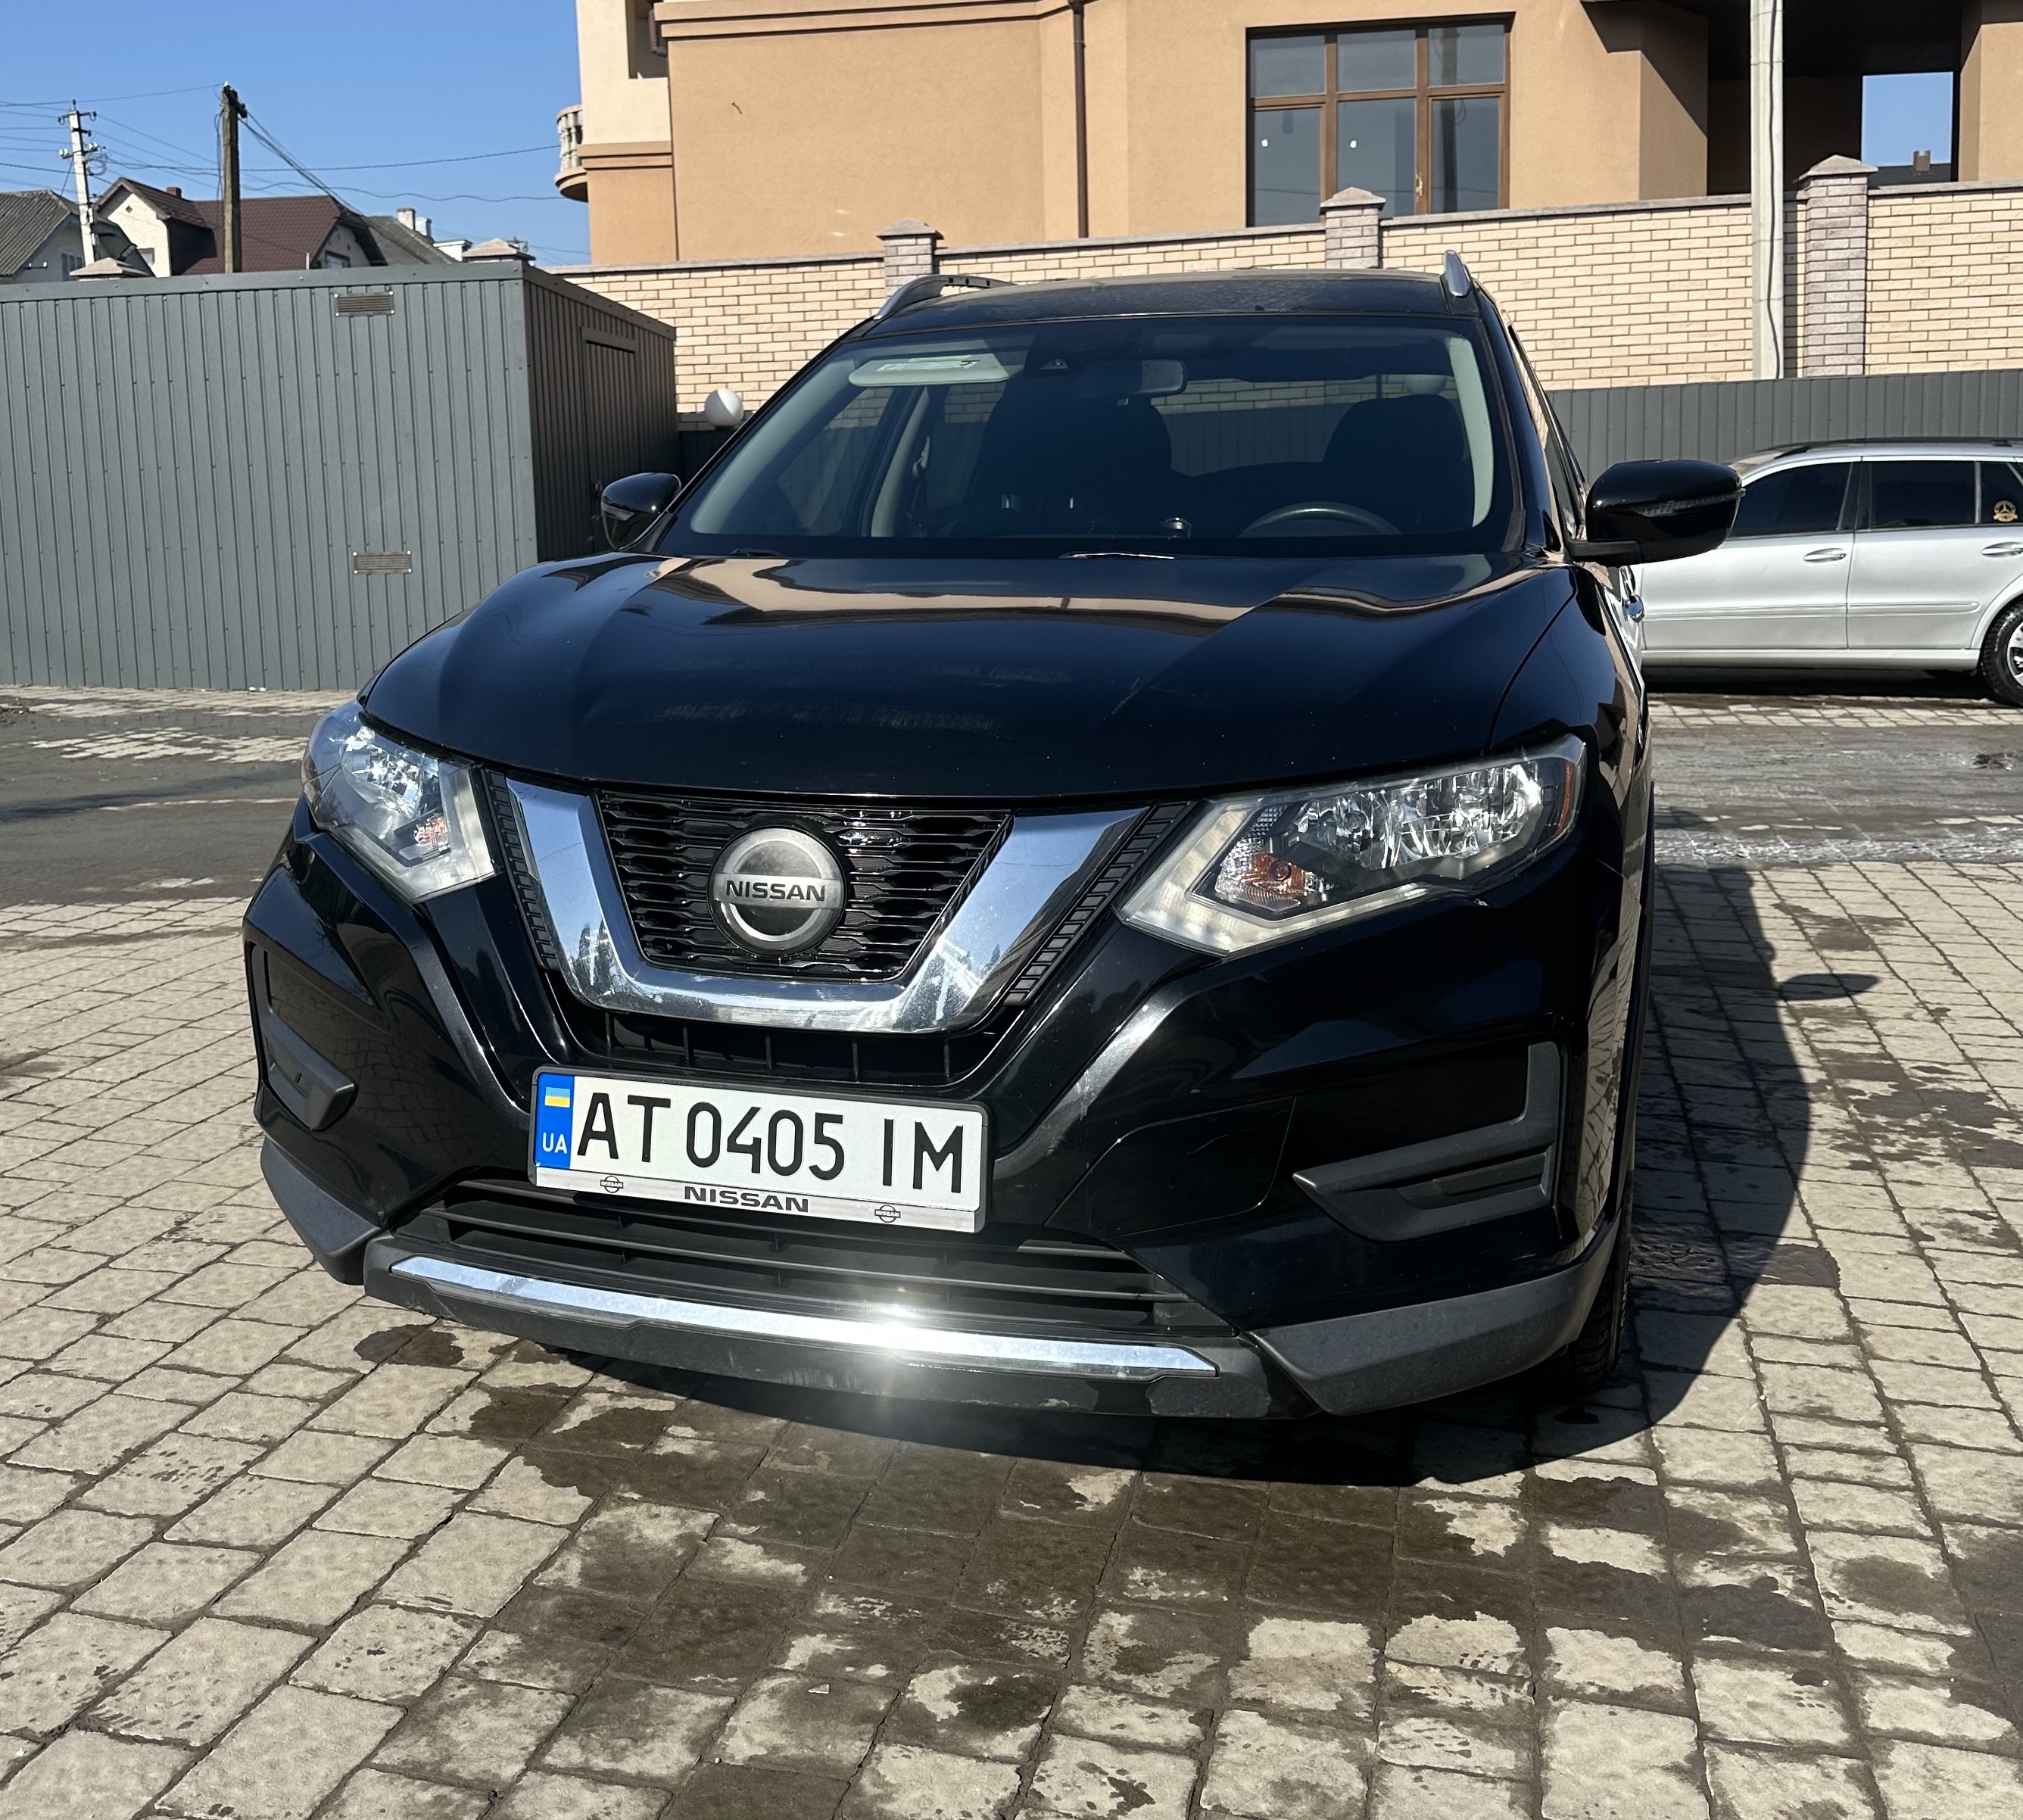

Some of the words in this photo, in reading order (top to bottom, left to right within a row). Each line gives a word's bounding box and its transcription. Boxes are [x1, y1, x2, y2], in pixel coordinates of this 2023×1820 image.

[725, 880, 826, 902] NISSAN
[541, 1132, 568, 1154] UA
[577, 1092, 672, 1163] AT
[686, 1102, 845, 1181] 0405
[883, 1117, 963, 1194] IM
[684, 1186, 809, 1213] NISSAN
